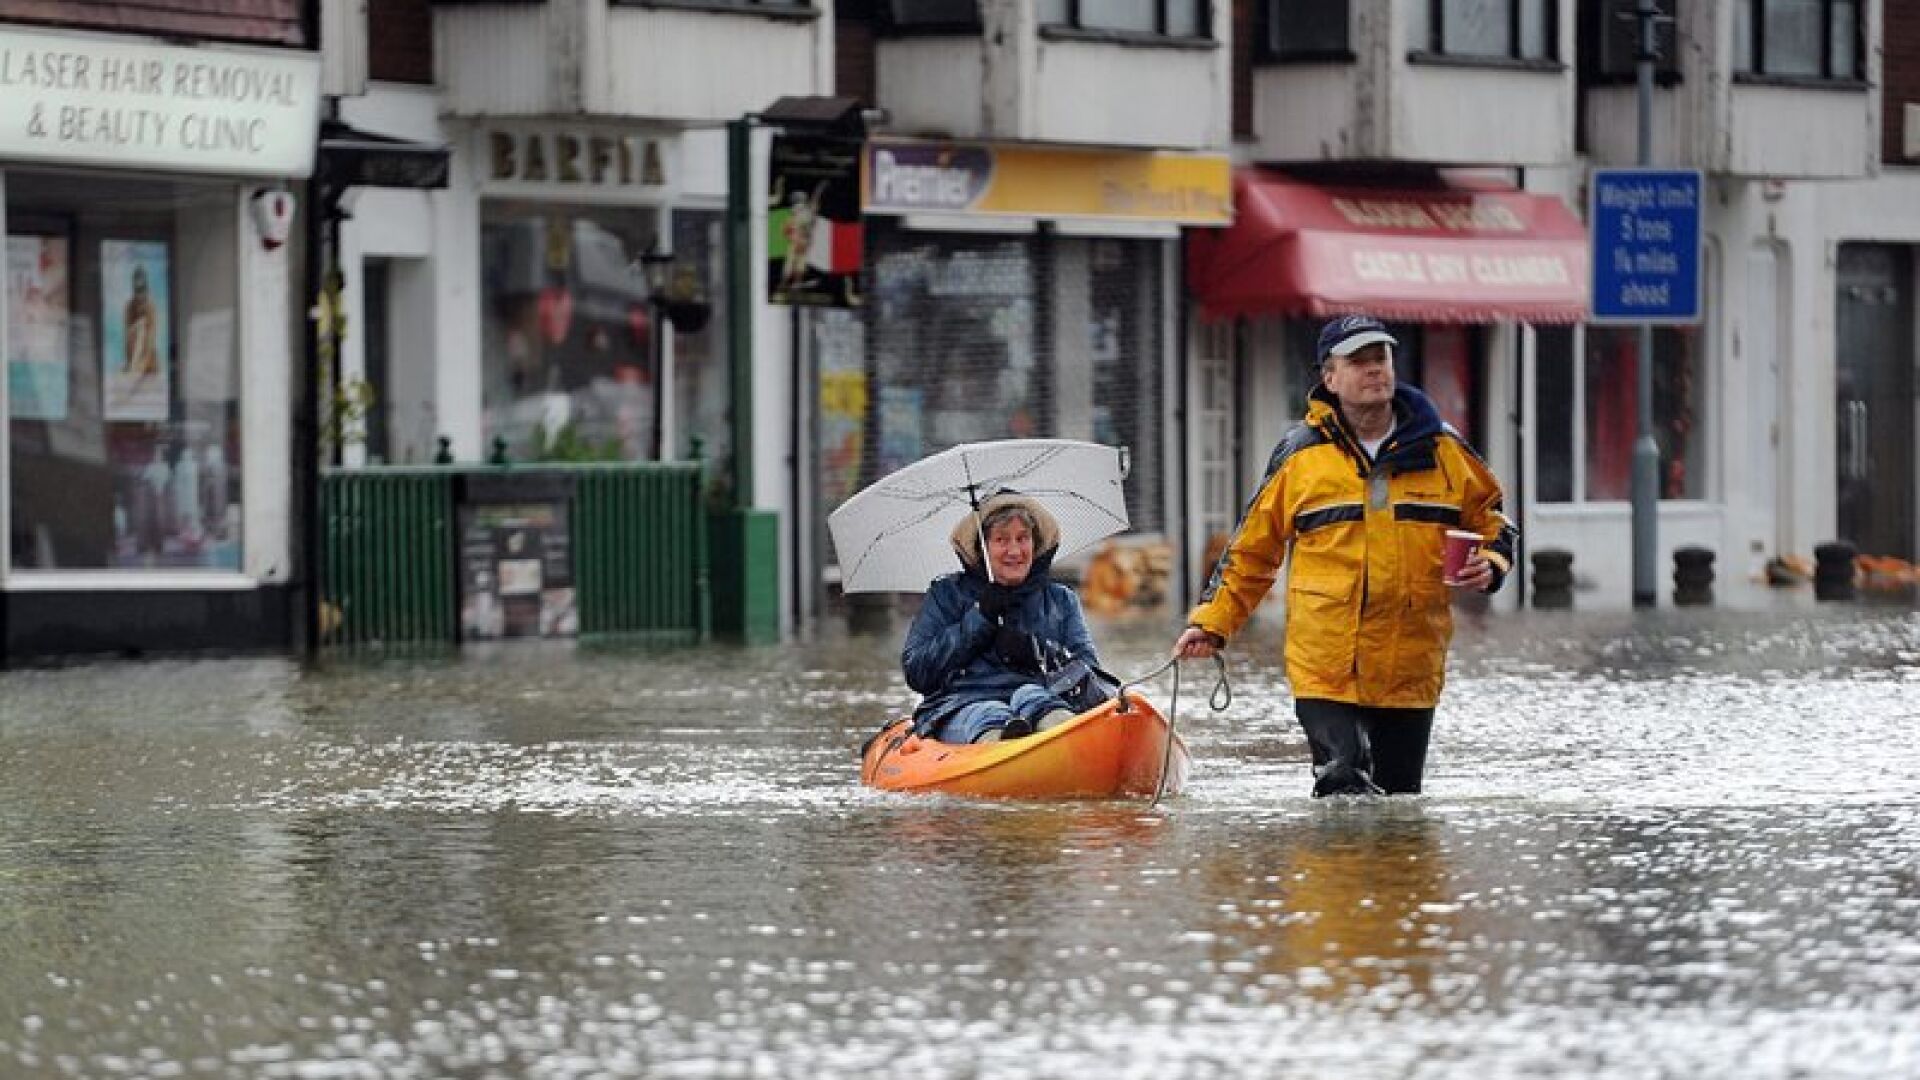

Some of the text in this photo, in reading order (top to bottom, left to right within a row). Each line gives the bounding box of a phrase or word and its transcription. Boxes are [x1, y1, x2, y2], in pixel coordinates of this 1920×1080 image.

[1, 49, 298, 106] LASER HAIR REMOVAL
[26, 102, 266, 152] & BEAUTY CLINIC
[875, 151, 970, 203] Premier
[1601, 184, 1654, 213] Weight
[1353, 251, 1570, 286] CASTLE DRY CLEANERS
[1636, 247, 1678, 273] miles
[1621, 279, 1669, 305] ahead
